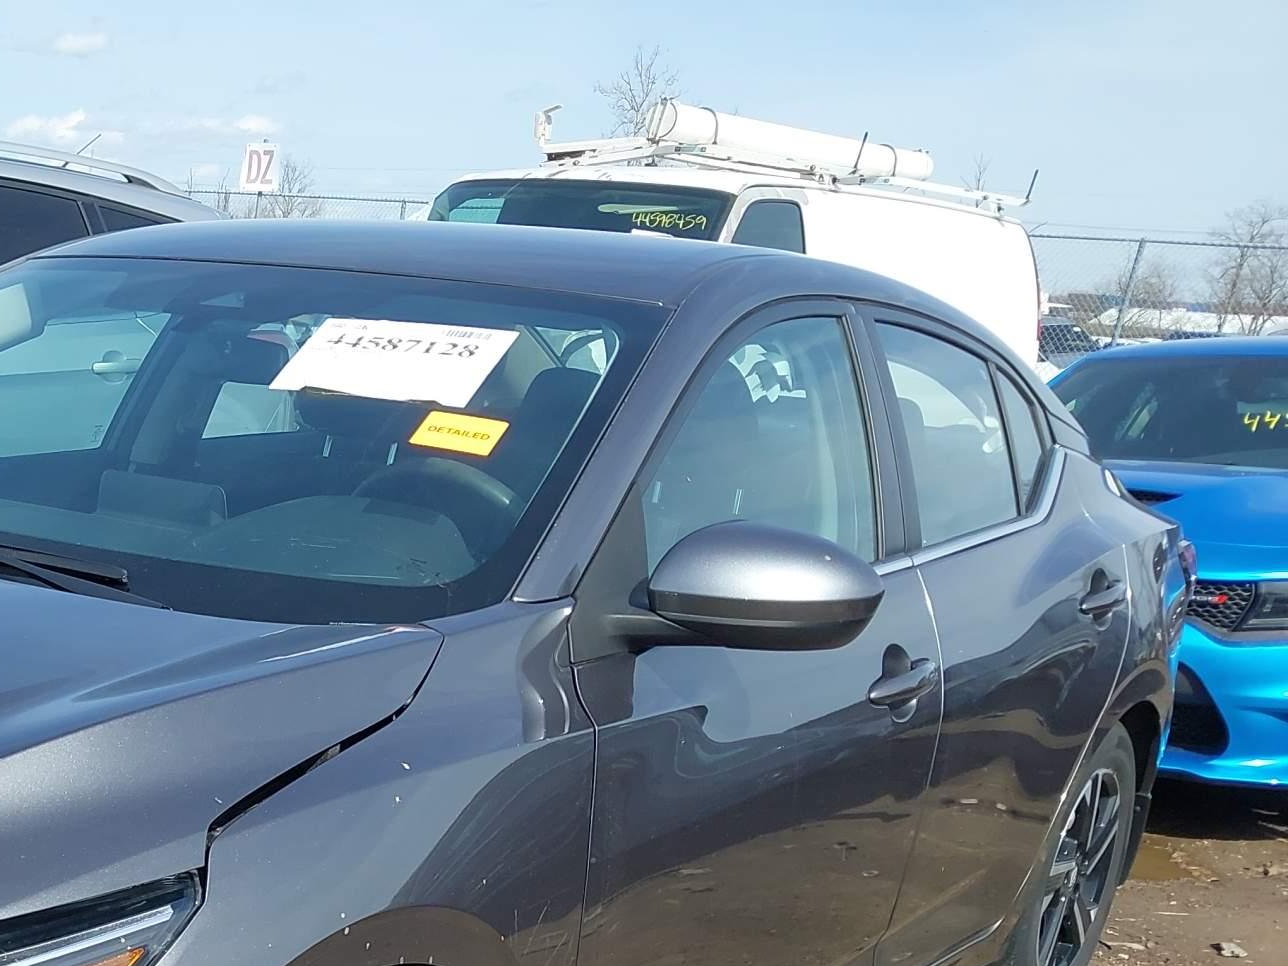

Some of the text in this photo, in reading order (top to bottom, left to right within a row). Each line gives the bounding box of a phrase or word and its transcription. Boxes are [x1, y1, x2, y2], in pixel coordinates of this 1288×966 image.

[246, 150, 274, 184] DZ
[632, 212, 707, 230] 44598459
[327, 333, 480, 358] 44587128
[427, 425, 491, 440] DETAILED
